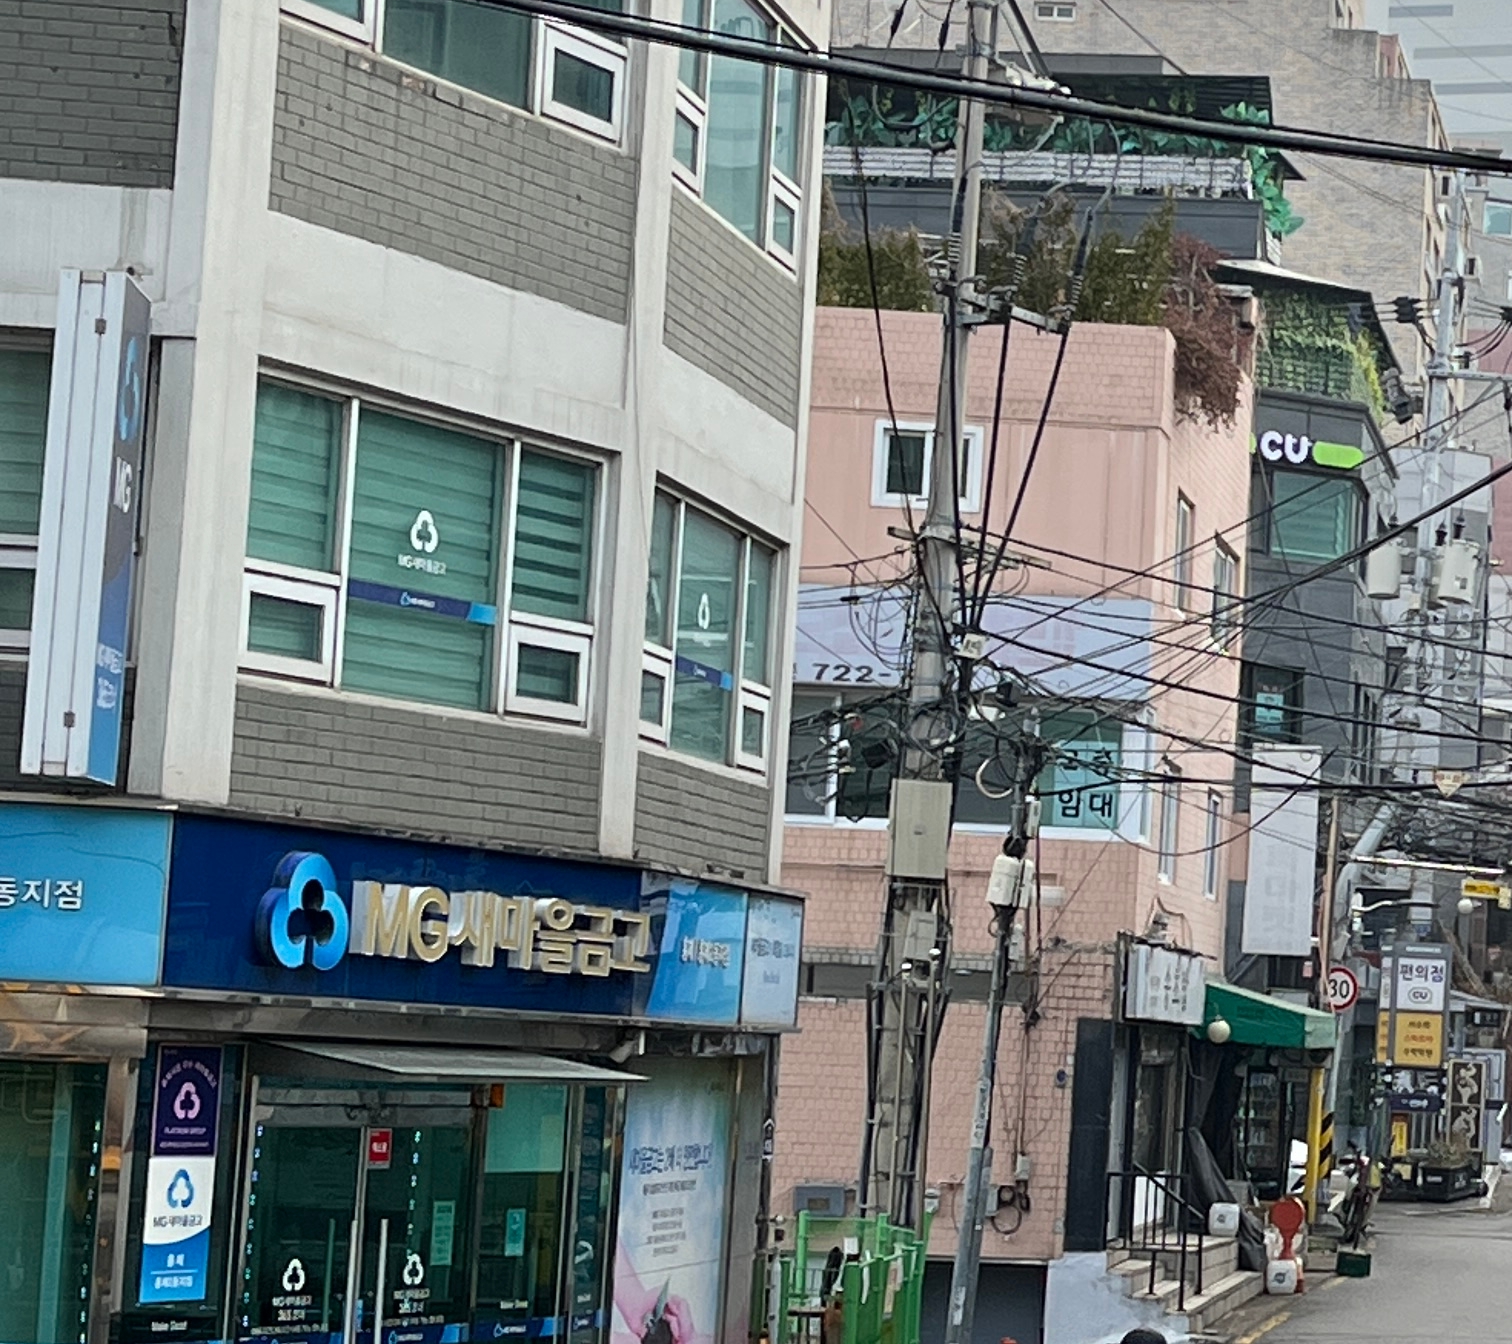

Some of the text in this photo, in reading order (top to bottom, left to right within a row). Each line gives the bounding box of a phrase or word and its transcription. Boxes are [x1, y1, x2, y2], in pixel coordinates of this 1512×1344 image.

[1259, 429, 1313, 464] CU
[1058, 789, 1114, 819] 임대
[350, 880, 652, 977] MG새마을금고
[1328, 979, 1351, 999] 30
